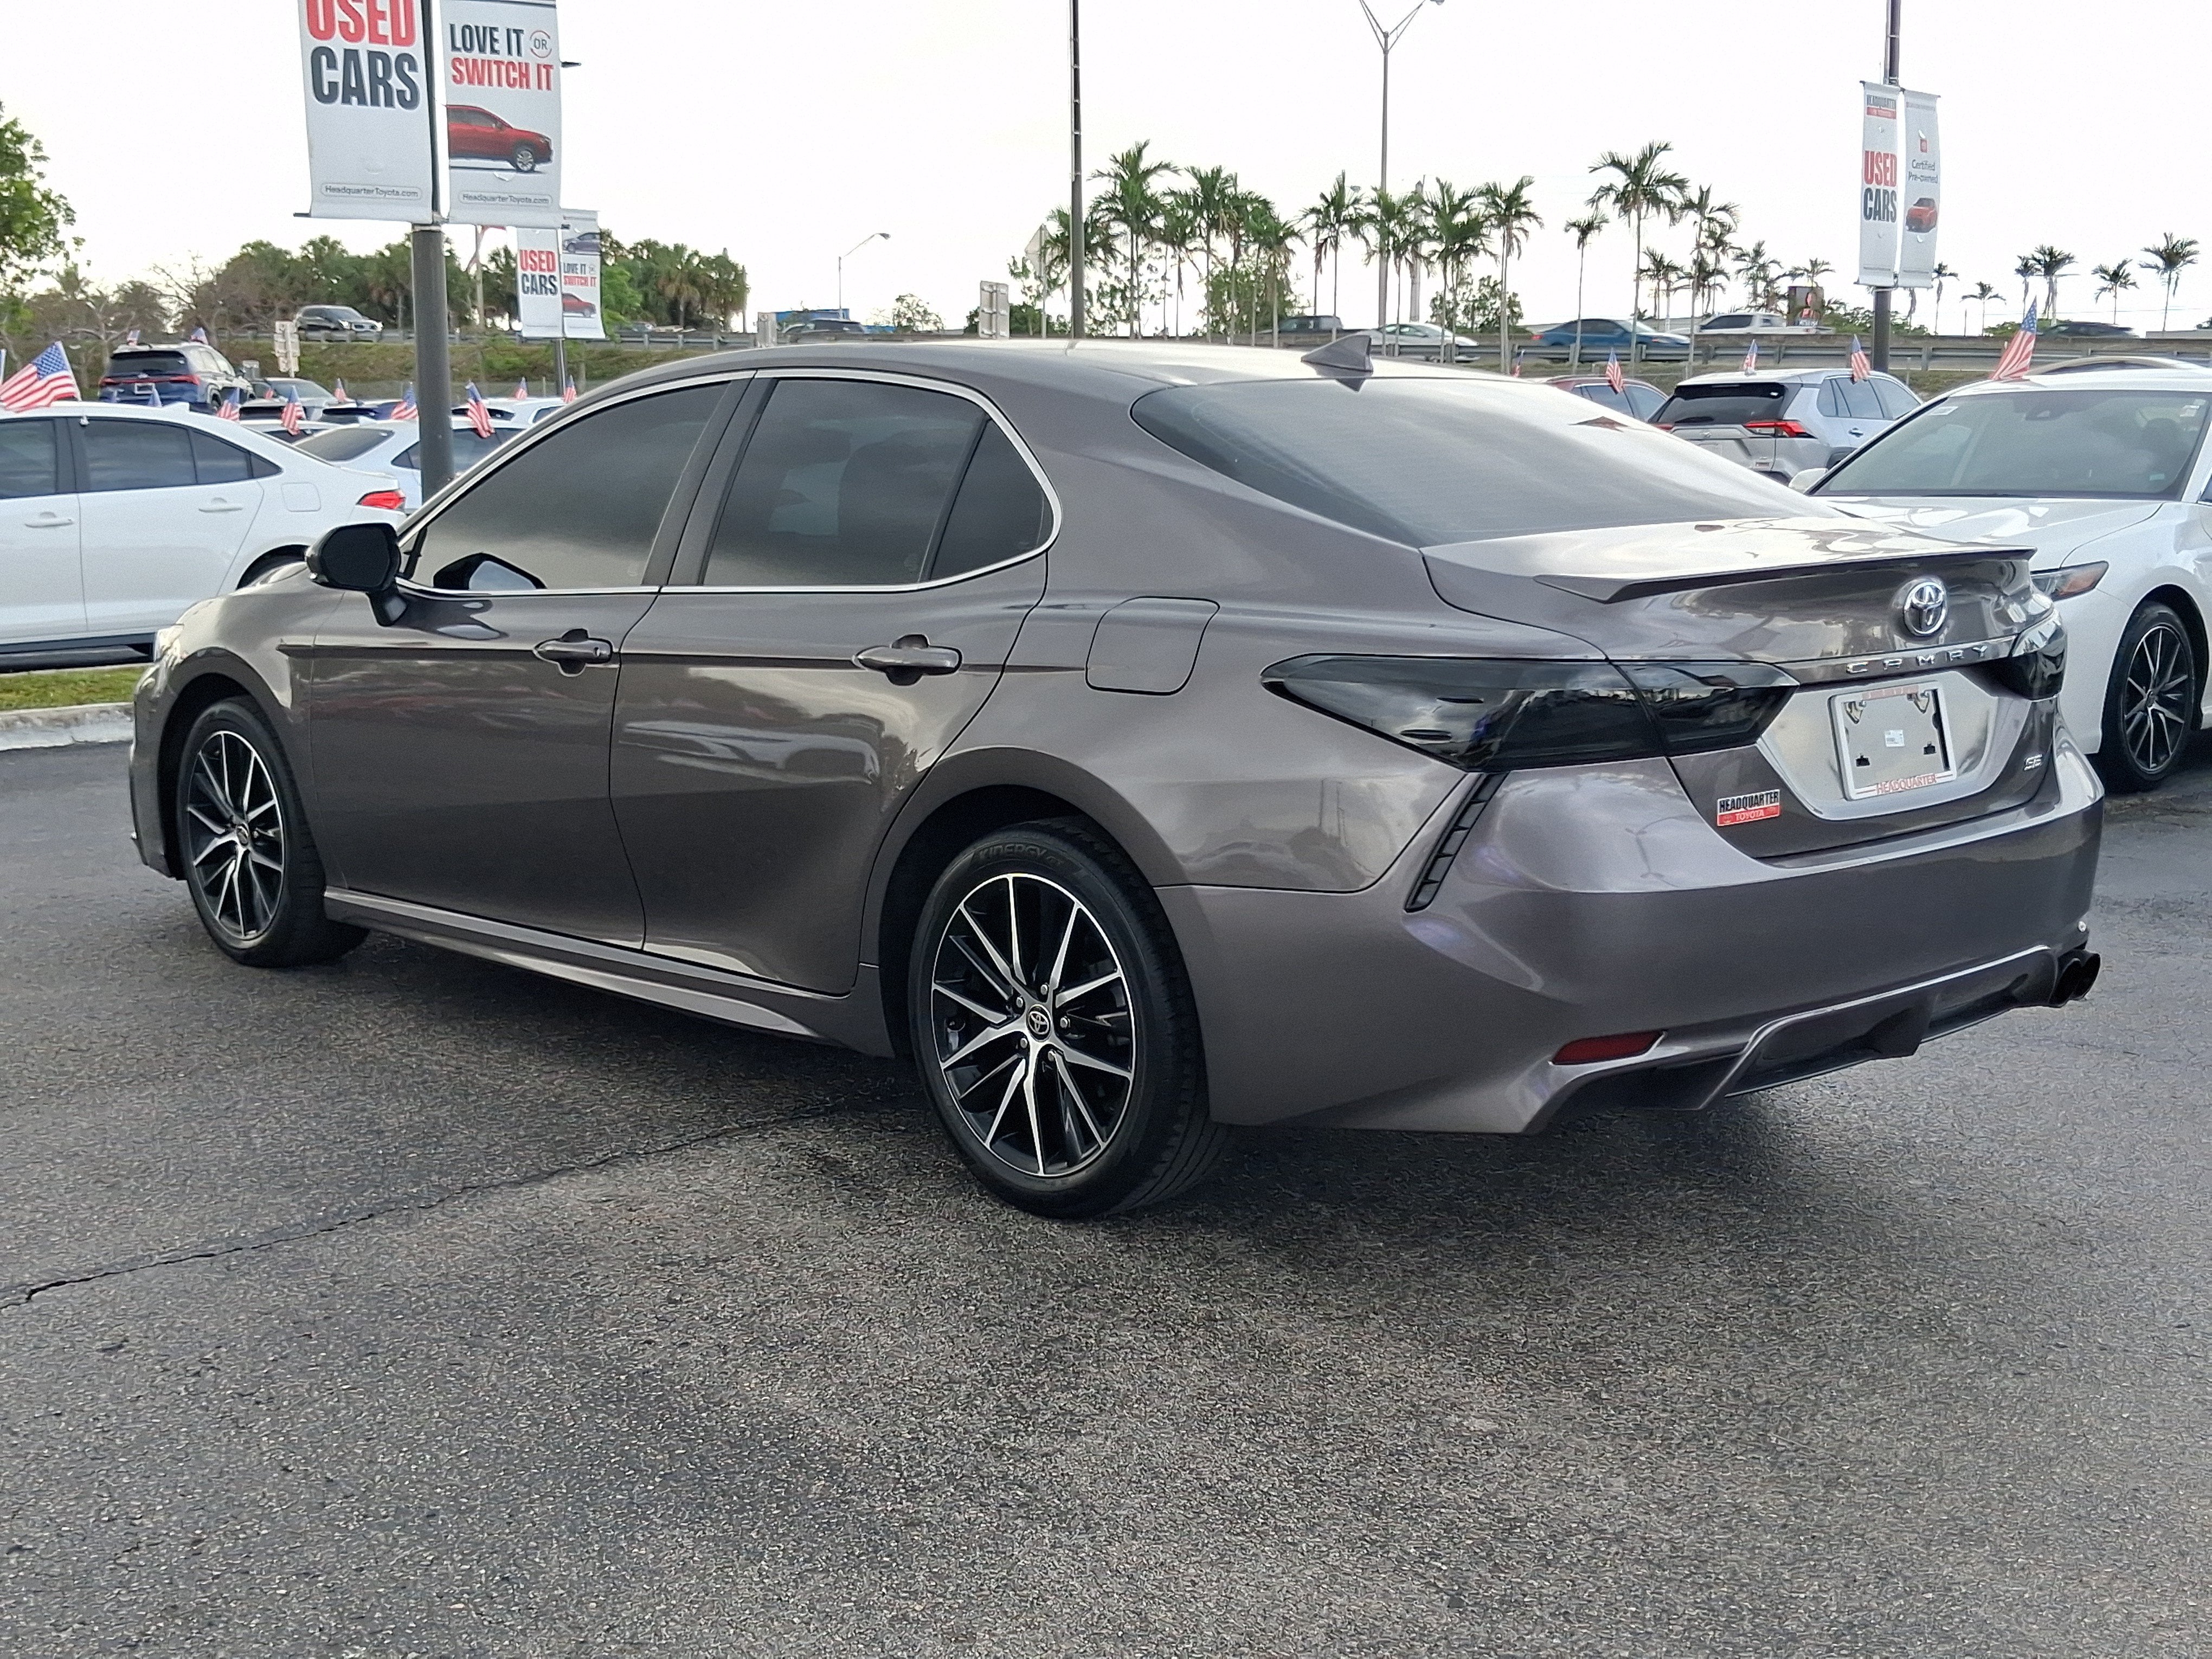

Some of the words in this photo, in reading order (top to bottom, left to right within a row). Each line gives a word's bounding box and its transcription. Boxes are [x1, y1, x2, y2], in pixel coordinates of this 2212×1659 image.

[307, 0, 415, 47] USED
[450, 23, 500, 55] LOVE
[506, 27, 524, 56] IT
[533, 37, 548, 50] OR
[311, 46, 420, 110] CARS
[451, 57, 531, 89] SWITCH
[537, 63, 554, 91] IT
[1864, 150, 1897, 187] USED
[1912, 159, 1936, 171] Certified
[325, 185, 418, 198] HeadquarterToyota.com
[1863, 188, 1897, 223] CARS
[520, 249, 557, 272] USED
[580, 263, 587, 275] IT
[522, 273, 558, 295] CARS
[1846, 645, 1988, 673] CAMRY
[2024, 754, 2043, 771] SE
[1876, 774, 1937, 795] HEADQUARTER
[1719, 792, 1778, 813] HEADQUARTER
[1735, 809, 1765, 821] TOYOTA
